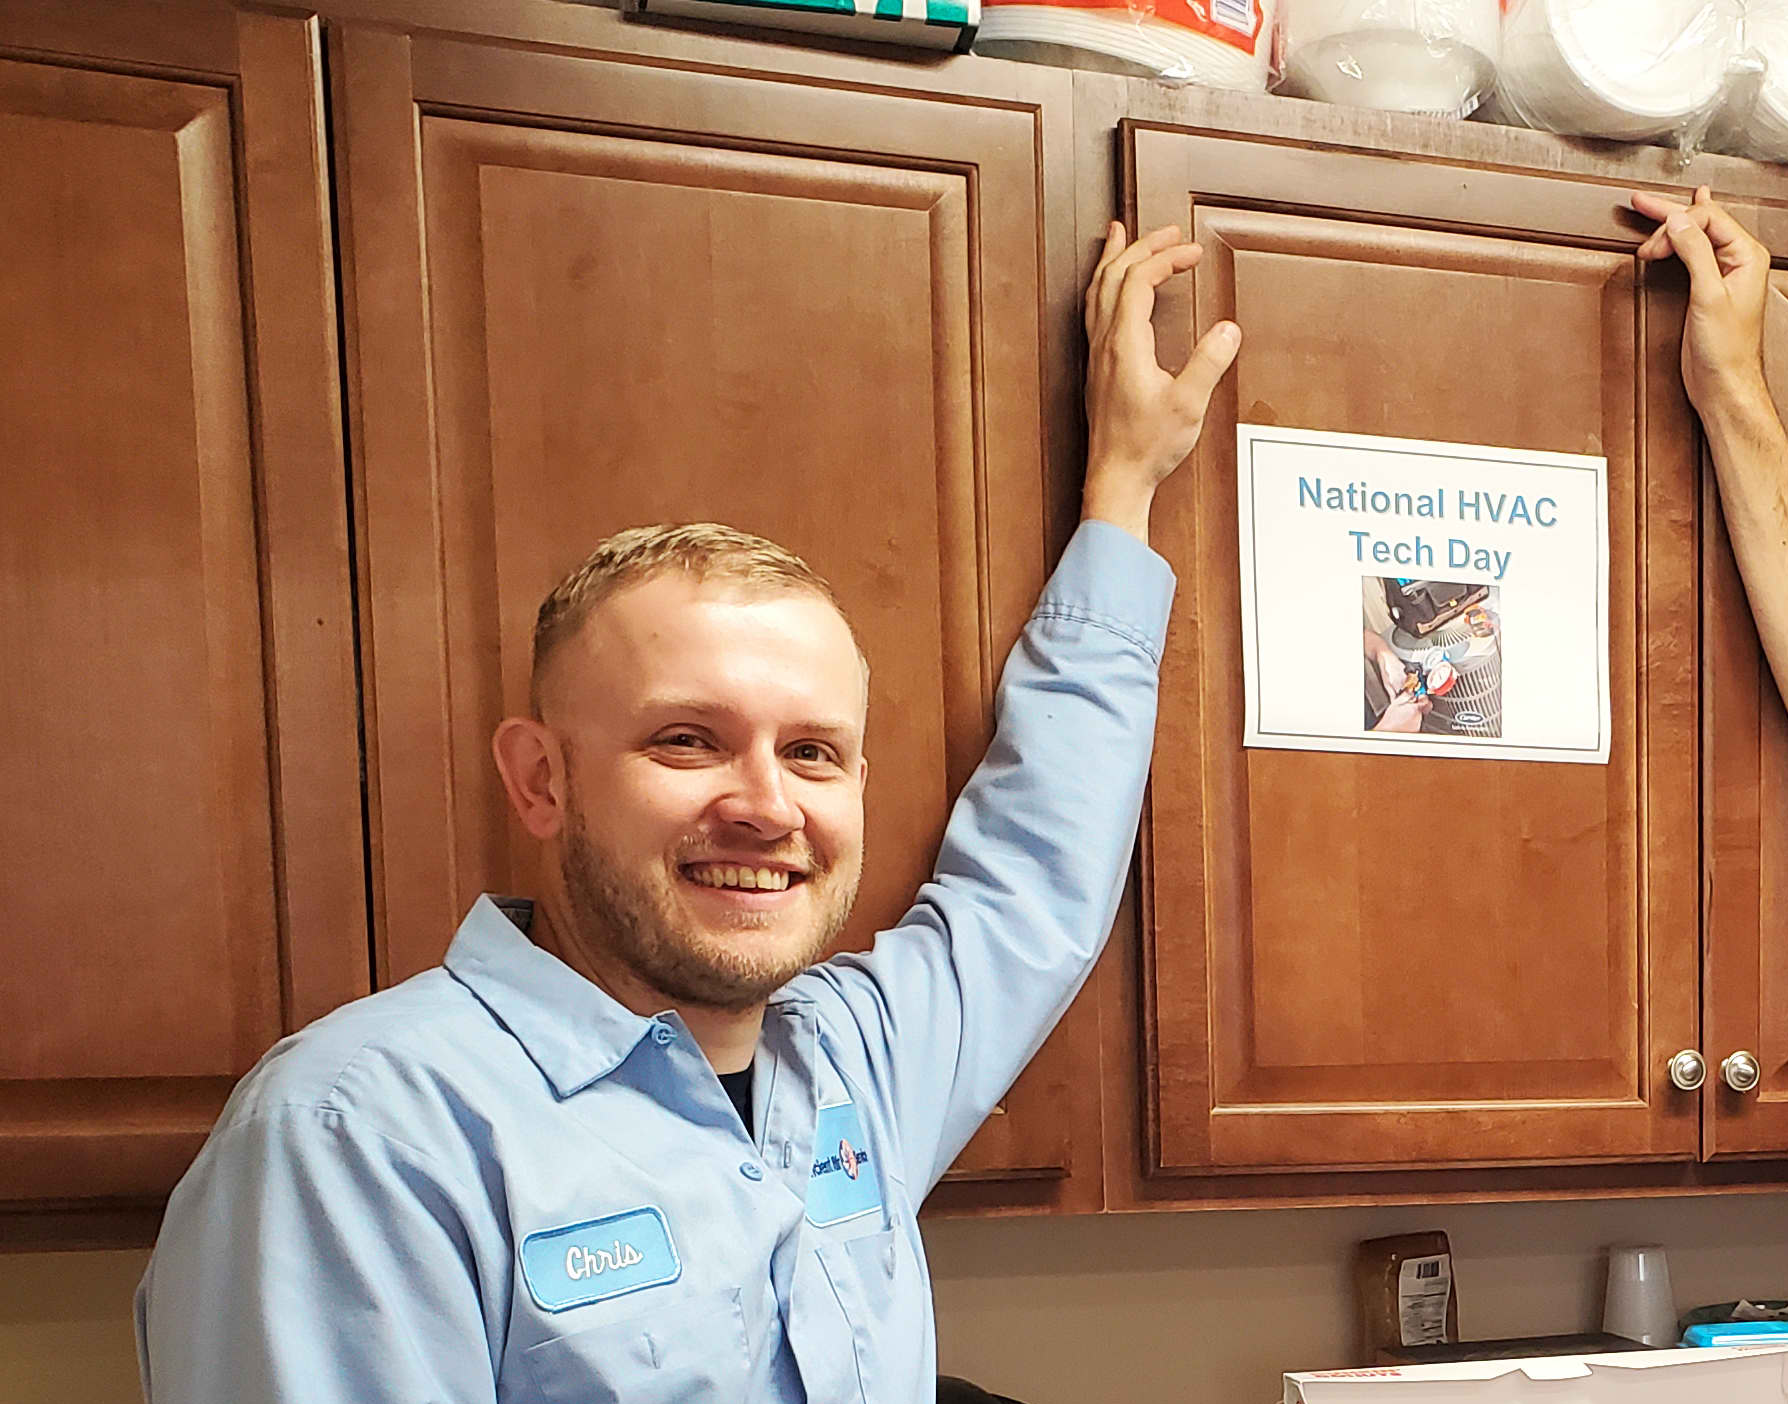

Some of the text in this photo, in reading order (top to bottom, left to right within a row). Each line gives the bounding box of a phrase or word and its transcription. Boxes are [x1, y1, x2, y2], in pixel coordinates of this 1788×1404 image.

[1299, 476, 1559, 527] National HVAC
[1348, 530, 1512, 581] Tech Day
[566, 1240, 644, 1280] Chris
